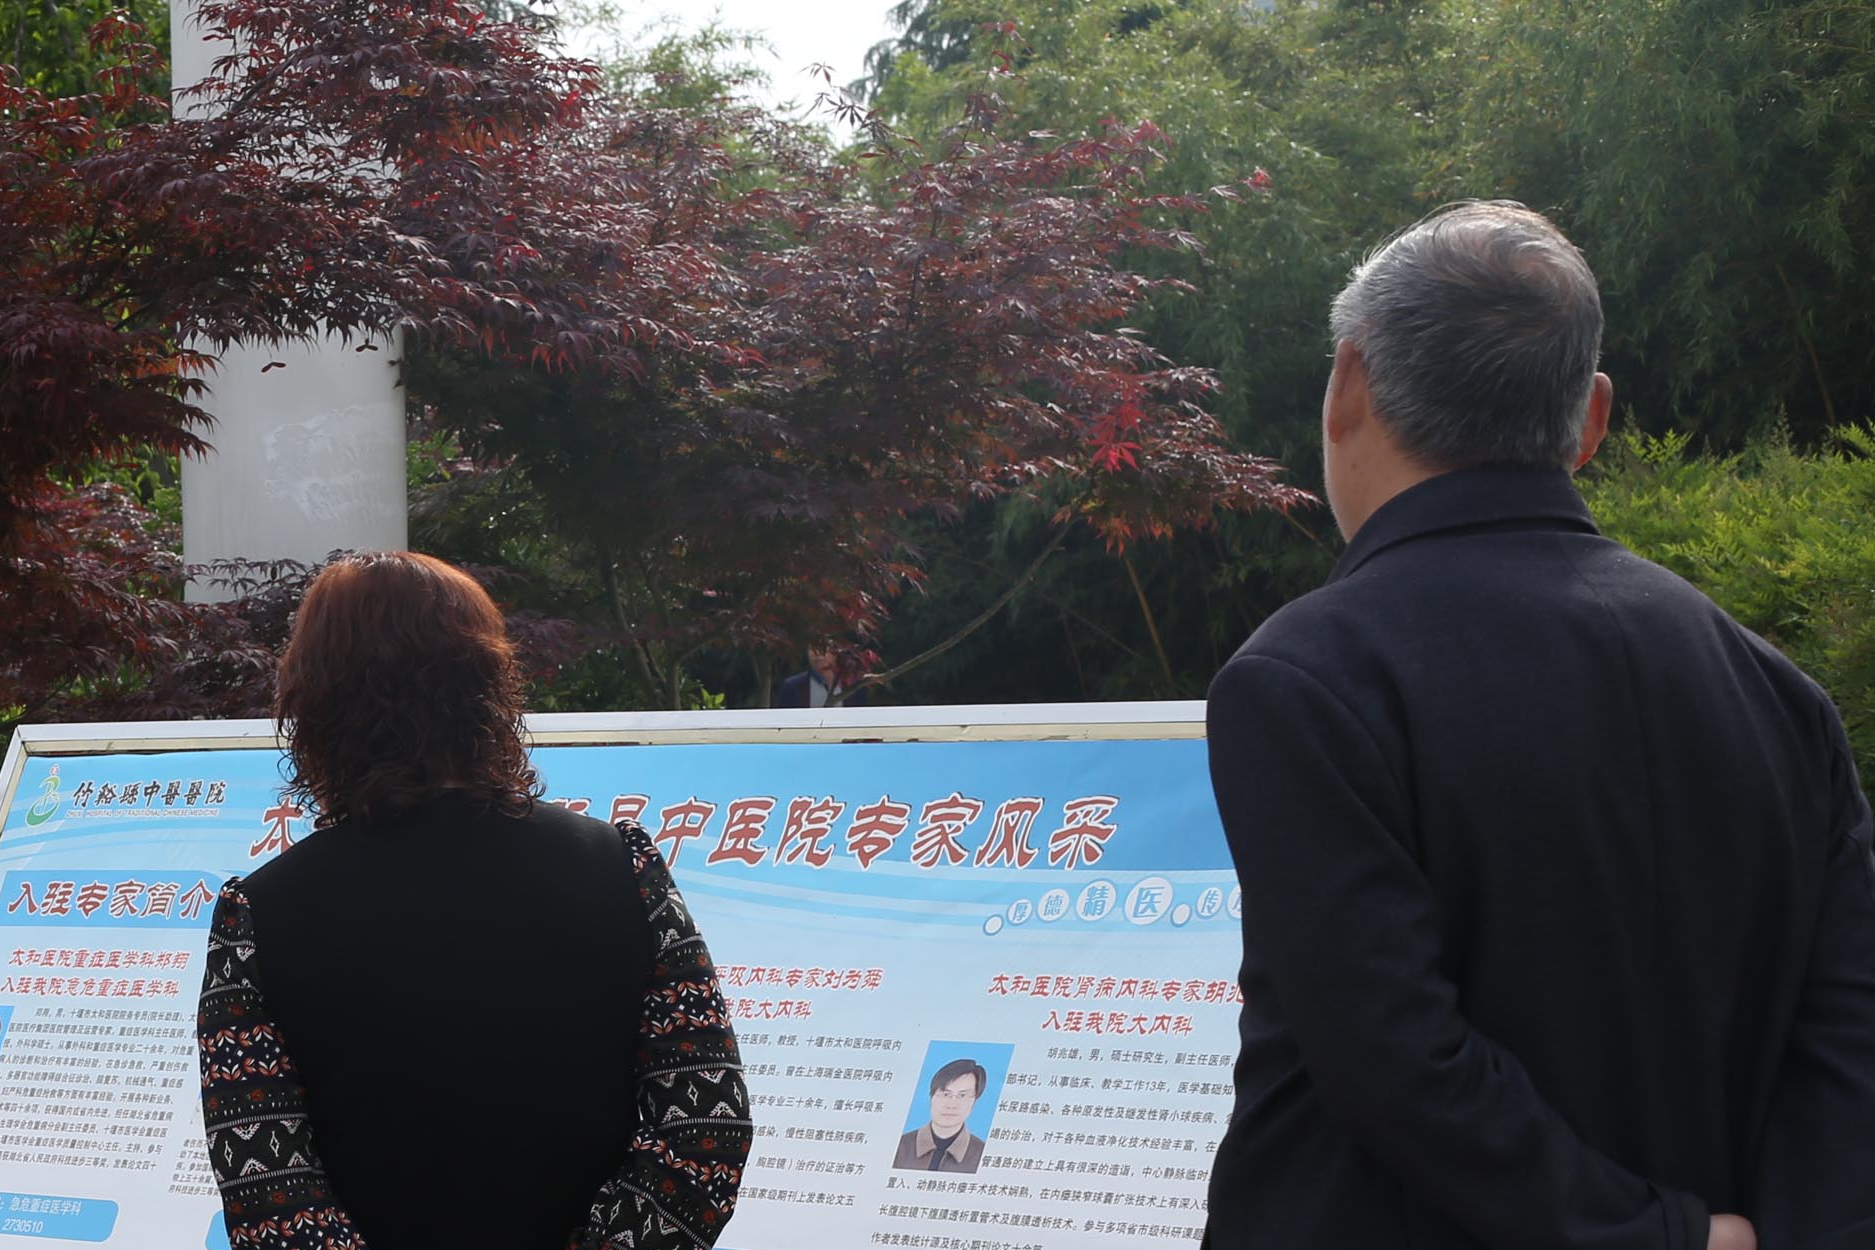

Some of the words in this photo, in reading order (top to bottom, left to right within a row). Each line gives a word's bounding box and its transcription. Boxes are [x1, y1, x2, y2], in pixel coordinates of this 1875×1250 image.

[8, 879, 215, 920] 入驻专家简介
[1041, 1009, 1194, 1036] 入驻我院大内科
